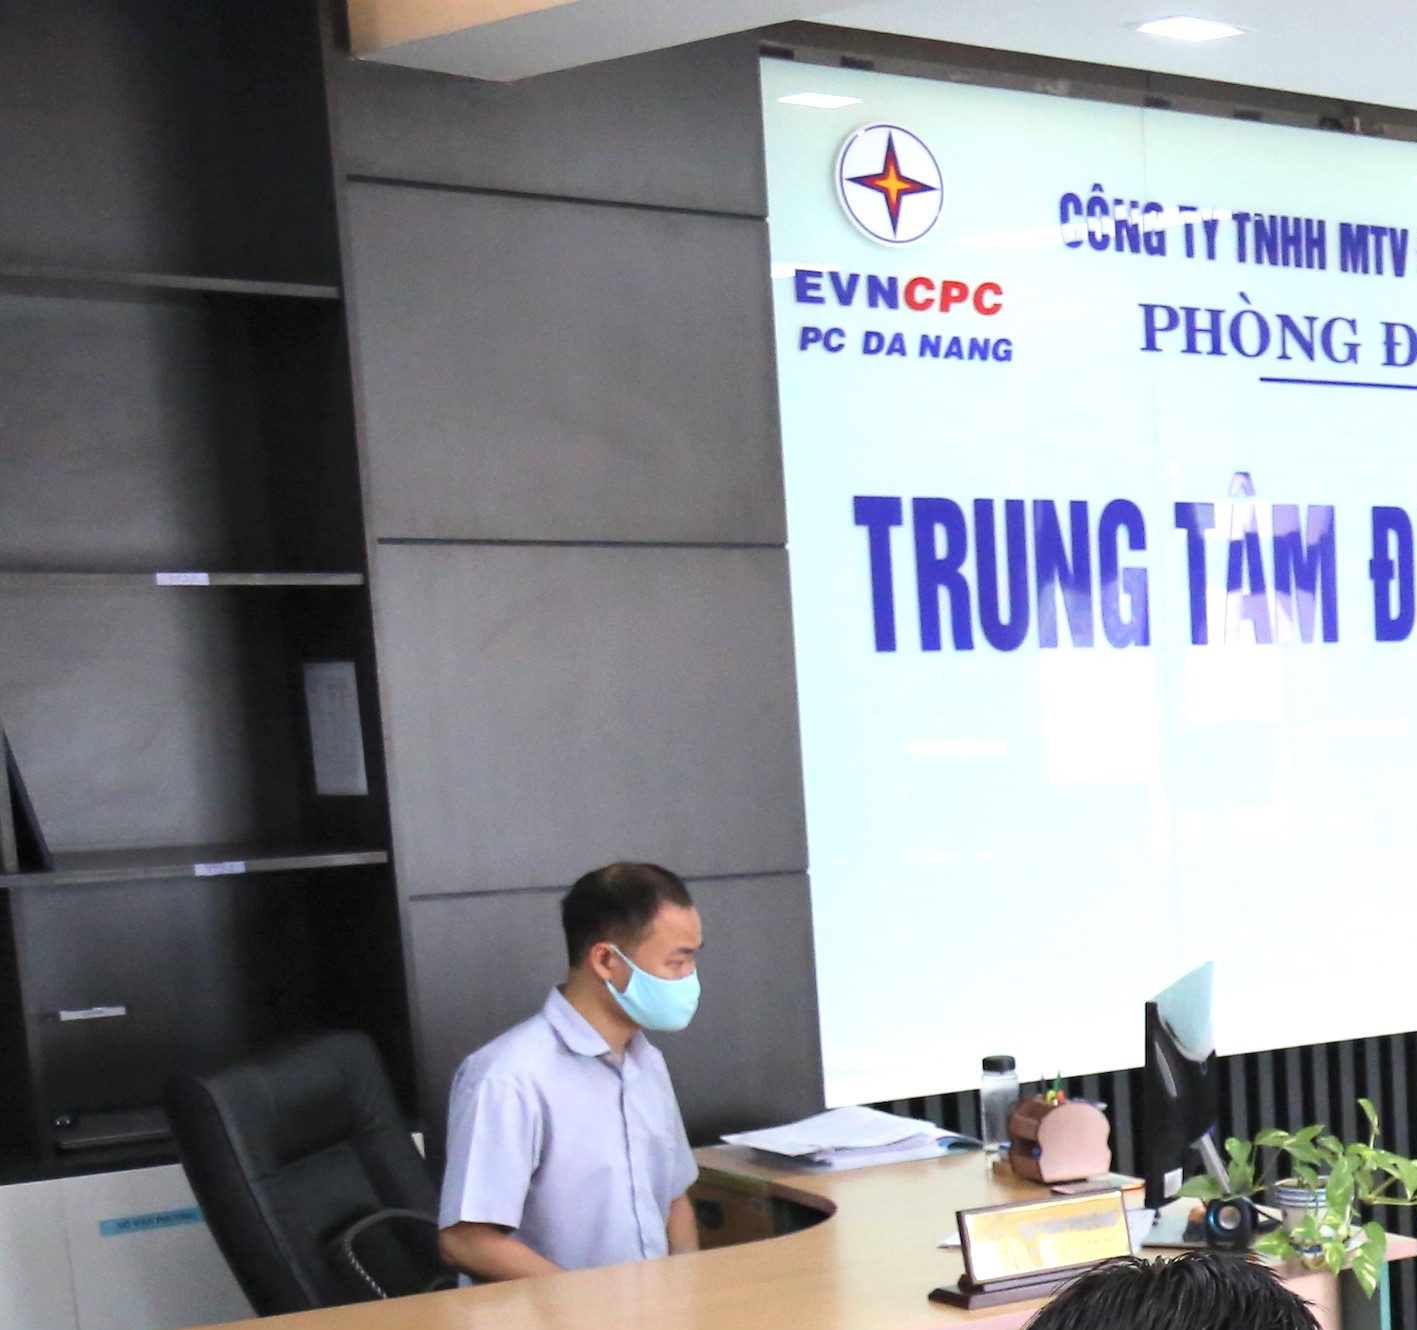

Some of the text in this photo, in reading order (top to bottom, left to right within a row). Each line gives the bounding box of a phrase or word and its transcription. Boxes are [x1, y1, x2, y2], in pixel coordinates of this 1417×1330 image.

[1060, 183, 1166, 257] CÔNG
[1178, 205, 1218, 260] TY
[1232, 212, 1327, 270] TNHH
[1339, 222, 1408, 277] MTV
[794, 269, 1004, 315] EVNCPC
[1138, 291, 1361, 365] PHÒNG
[799, 326, 1013, 362] PC DA NANG
[853, 496, 1150, 653] TRUNG
[1175, 472, 1339, 645] TÂM
